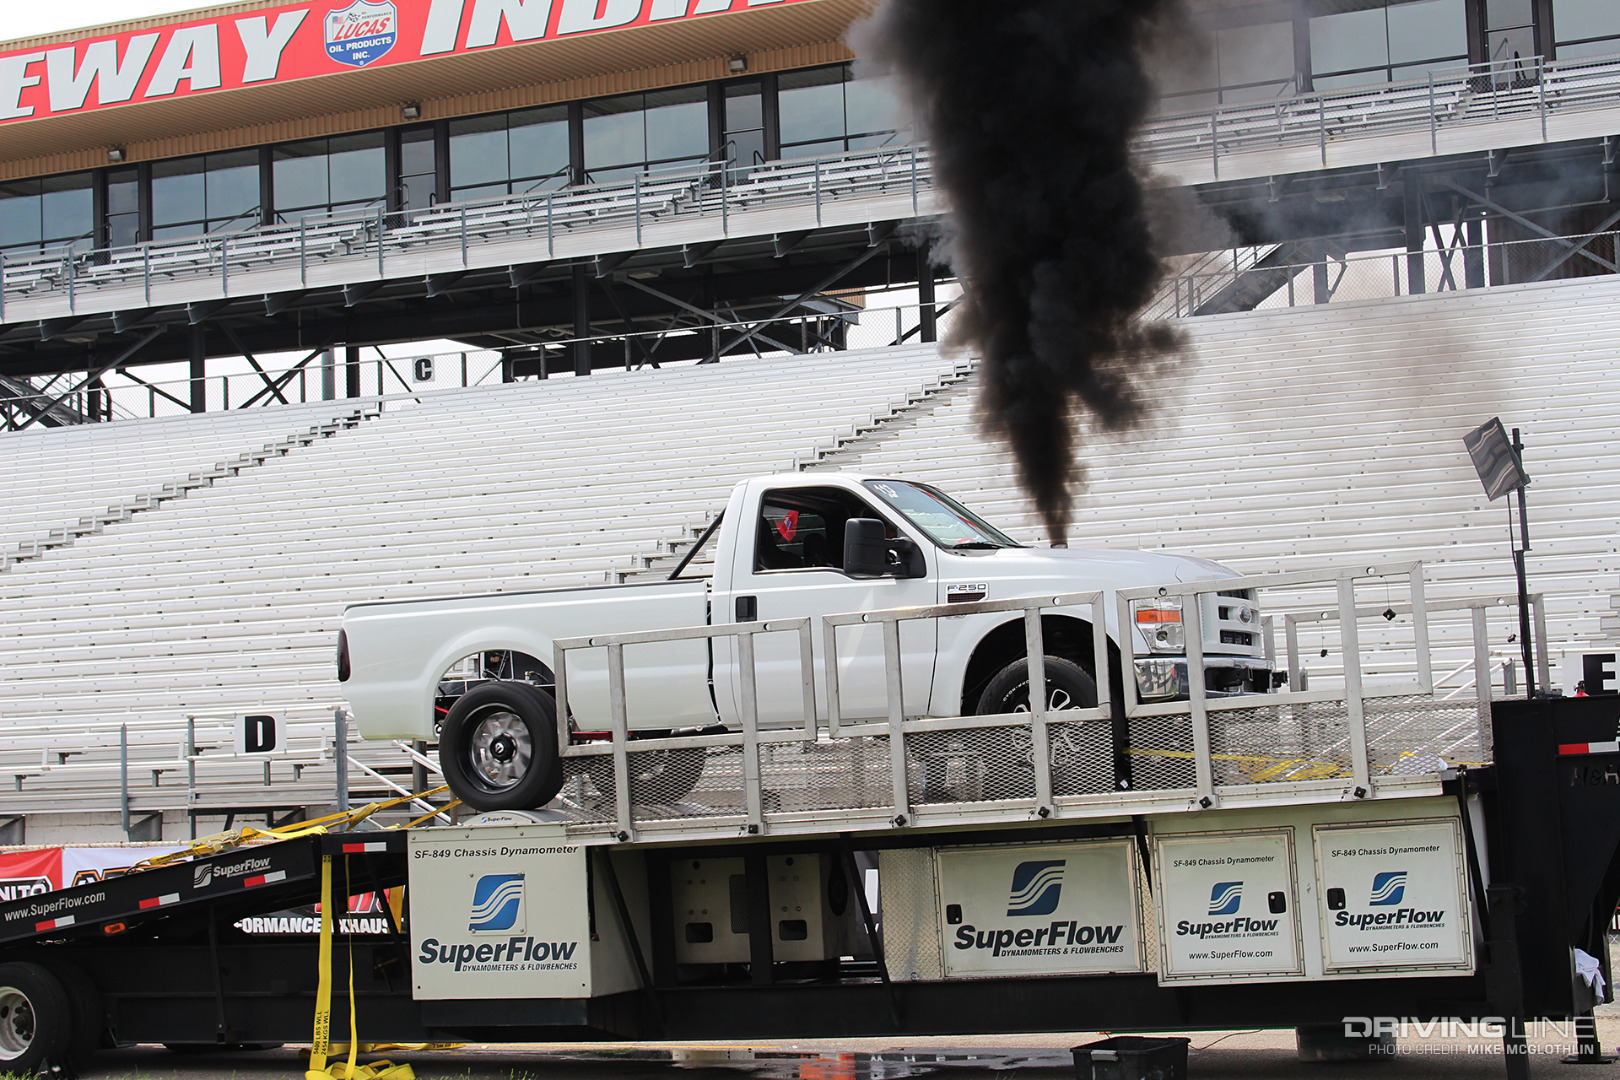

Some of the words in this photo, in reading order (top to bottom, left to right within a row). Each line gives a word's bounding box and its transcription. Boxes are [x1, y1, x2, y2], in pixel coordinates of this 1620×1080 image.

[334, 17, 391, 41] LUCAS
[329, 45, 344, 53] OIL
[346, 36, 392, 51] PRODUCTS
[352, 51, 371, 60] INC.
[415, 358, 431, 380] C
[947, 583, 987, 591] F-250
[1582, 653, 1619, 695] E
[244, 715, 277, 753] D
[414, 850, 451, 859] SF-849
[454, 847, 497, 858] Chassis
[500, 845, 579, 857] Dynamometer
[1331, 849, 1356, 857] SF-849
[1358, 848, 1387, 856] Chassis
[1389, 845, 1440, 855] Dynamometer
[213, 857, 271, 878] SuperFlow
[1198, 857, 1225, 866] Chassis
[1227, 856, 1275, 865] Dynamometer
[4, 891, 106, 921] www.SuperFlow.com
[1176, 917, 1279, 939] SuperFlow
[1335, 908, 1445, 931] SuperFlow
[954, 920, 1124, 957] SuperFlow
[1348, 941, 1439, 953] www.SuperFlow.com
[418, 936, 578, 971] SuperFlow
[1001, 947, 1061, 957] DYNAMOMETERS
[1062, 947, 1069, 955] &
[1071, 945, 1124, 954] FLOWBENCHES
[1188, 950, 1273, 960] www.SuperFlow.com
[462, 963, 519, 972] DYNAMOMETERS
[519, 963, 526, 971] &
[527, 962, 578, 971] FLOWBENCHES
